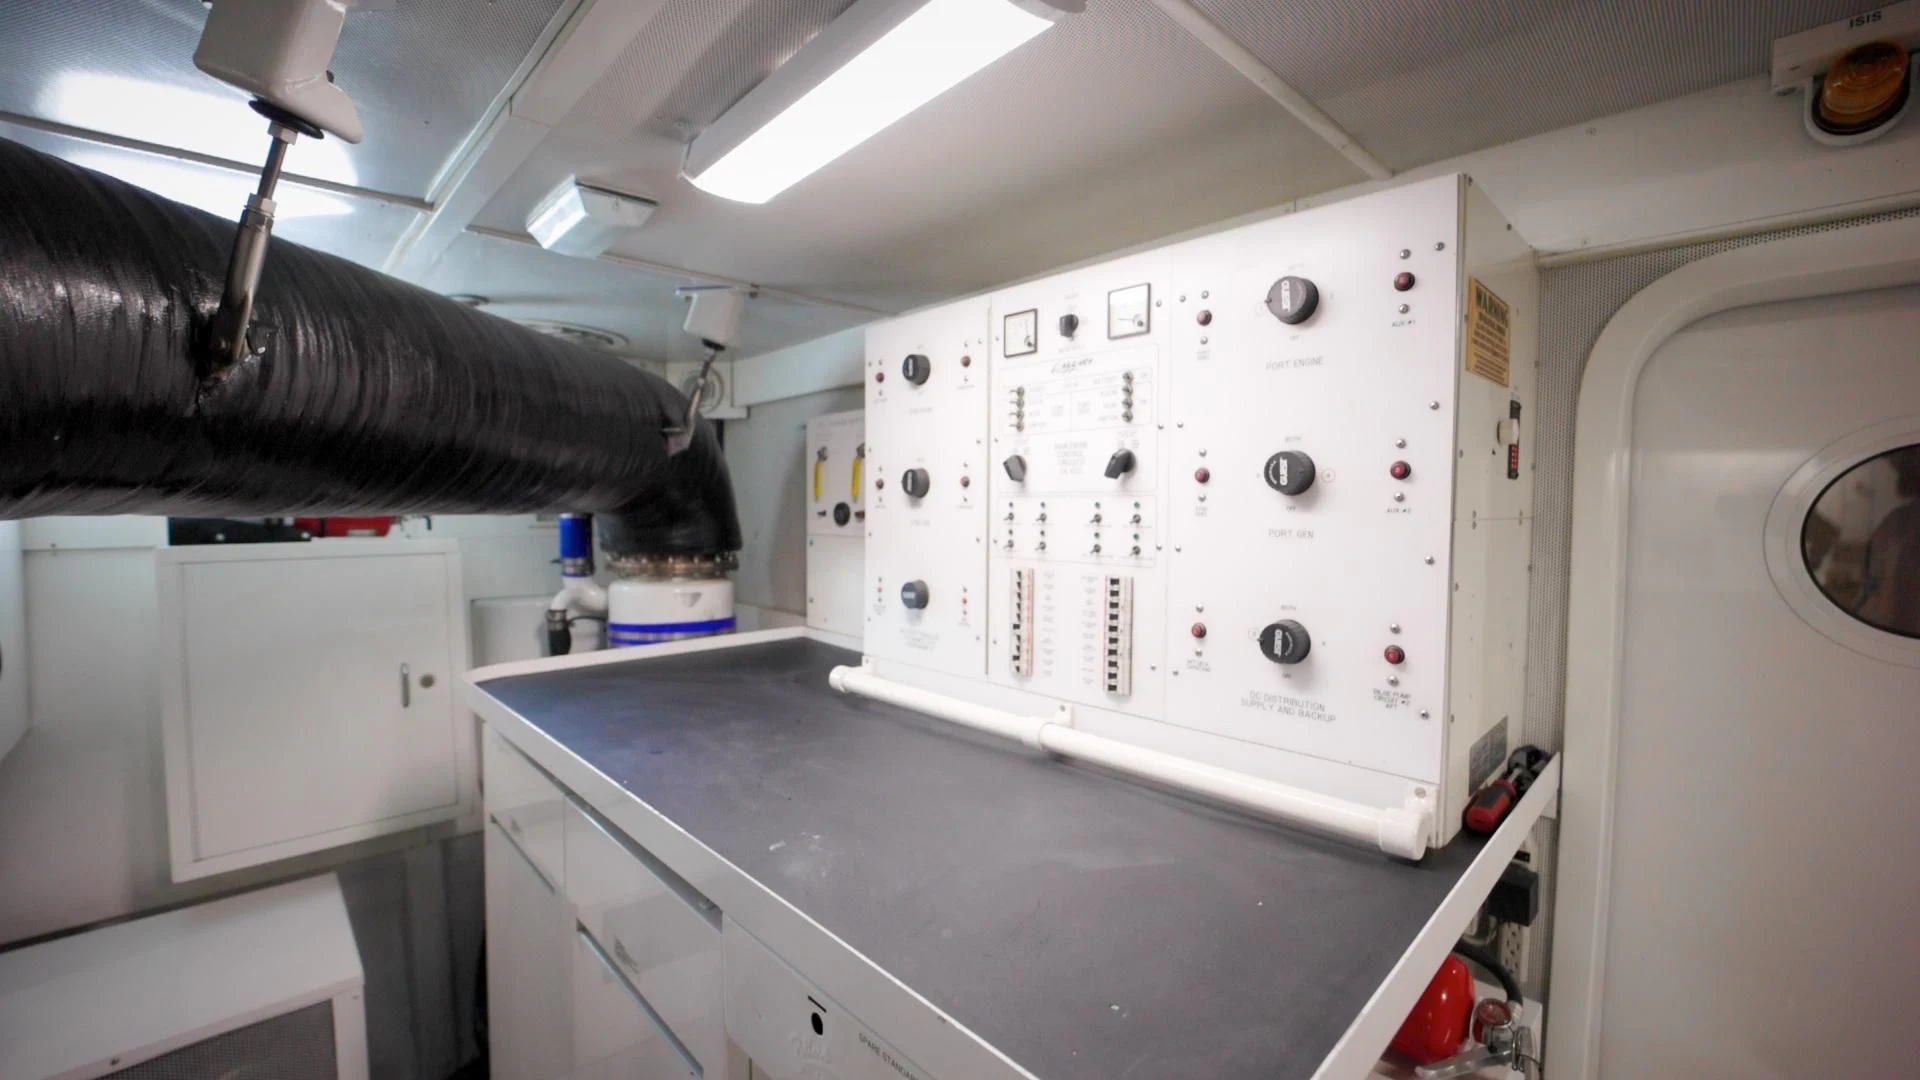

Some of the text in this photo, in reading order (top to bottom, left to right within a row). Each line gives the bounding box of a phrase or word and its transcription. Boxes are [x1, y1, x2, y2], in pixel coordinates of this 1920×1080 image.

[1849, 10, 1882, 28] ISIS
[1265, 355, 1324, 371] PORT ENGINE
[1267, 528, 1314, 540] PORT GEN
[1240, 697, 1337, 723] SUPPLY AND BACKUP
[1249, 690, 1326, 713] DC DISTRIBUTION
[858, 1031, 882, 1057] SPARE
